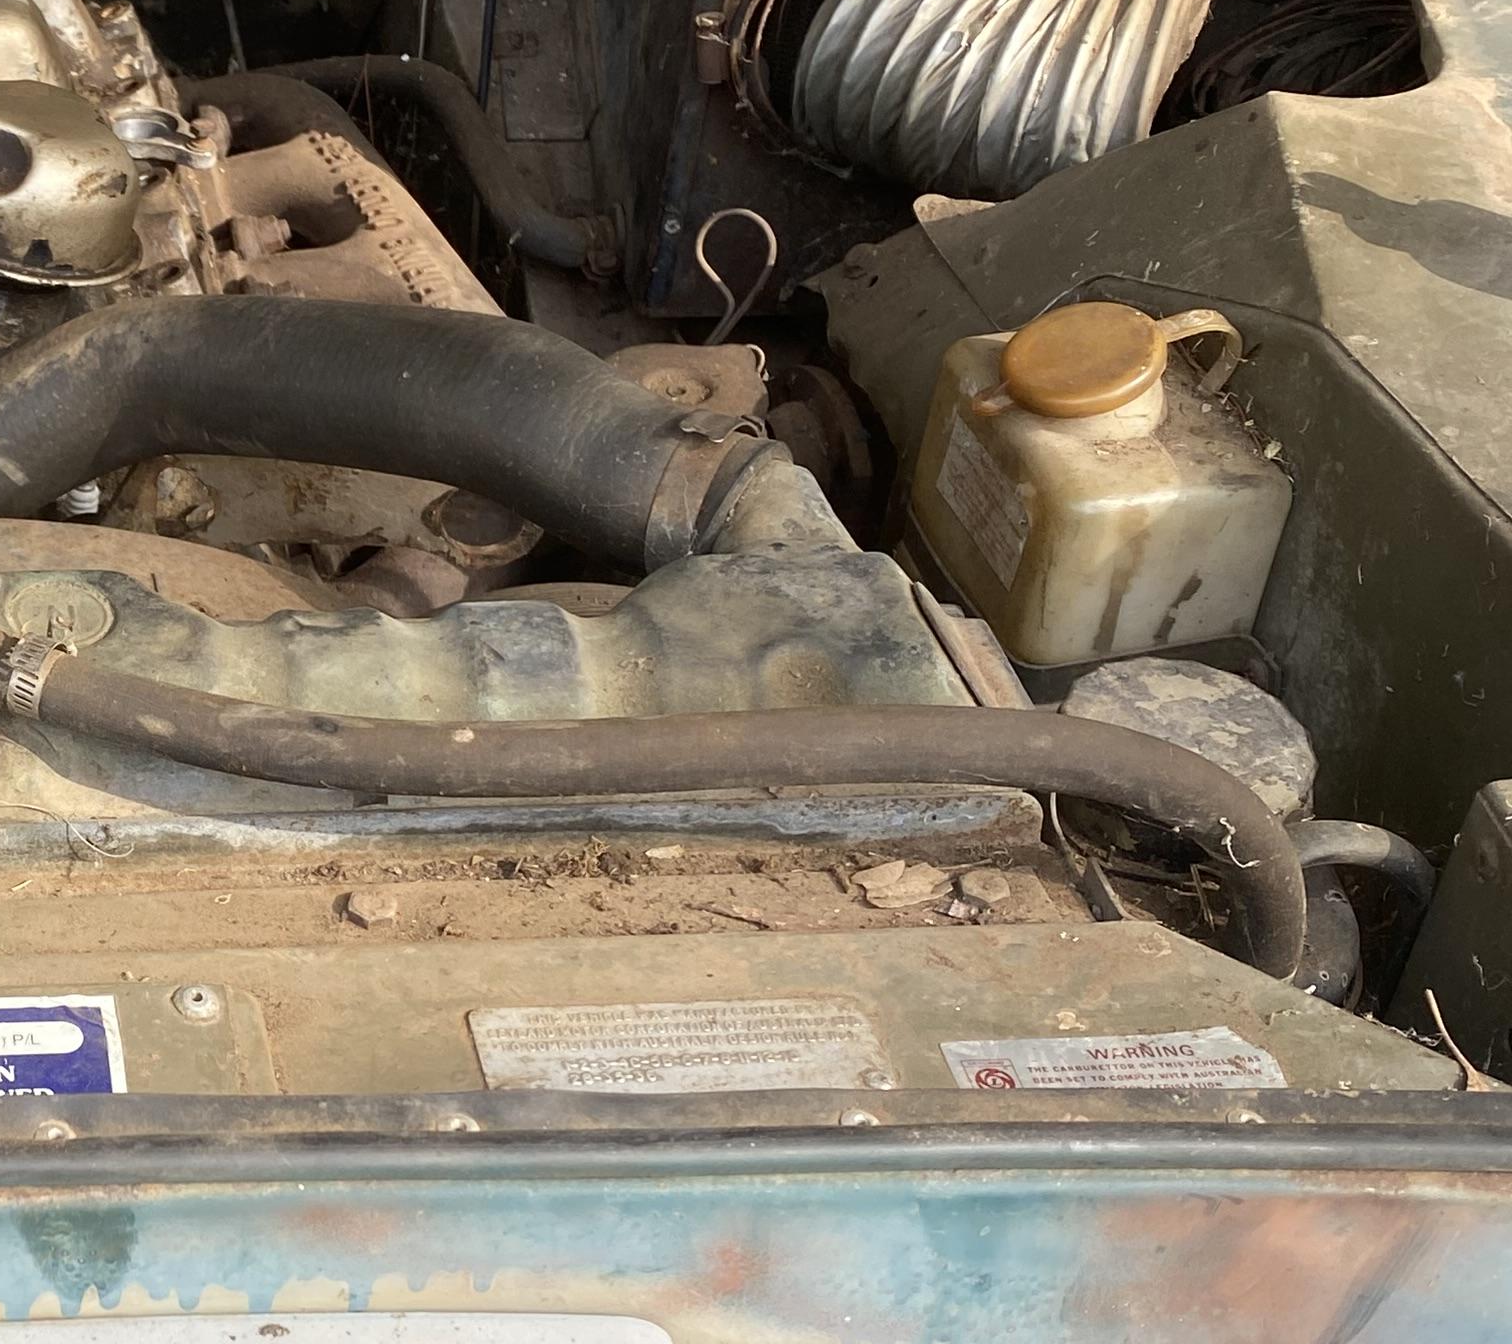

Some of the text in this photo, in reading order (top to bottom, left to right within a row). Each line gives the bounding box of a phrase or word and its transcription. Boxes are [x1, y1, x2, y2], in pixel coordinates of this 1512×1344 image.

[13, 1033, 41, 1046] P/L
[1084, 1043, 1200, 1060] WARNING
[1050, 1063, 1137, 1072] CARBURETTOR
[1156, 1060, 1186, 1068] THIS
[1184, 1057, 1234, 1066] VEHICL
